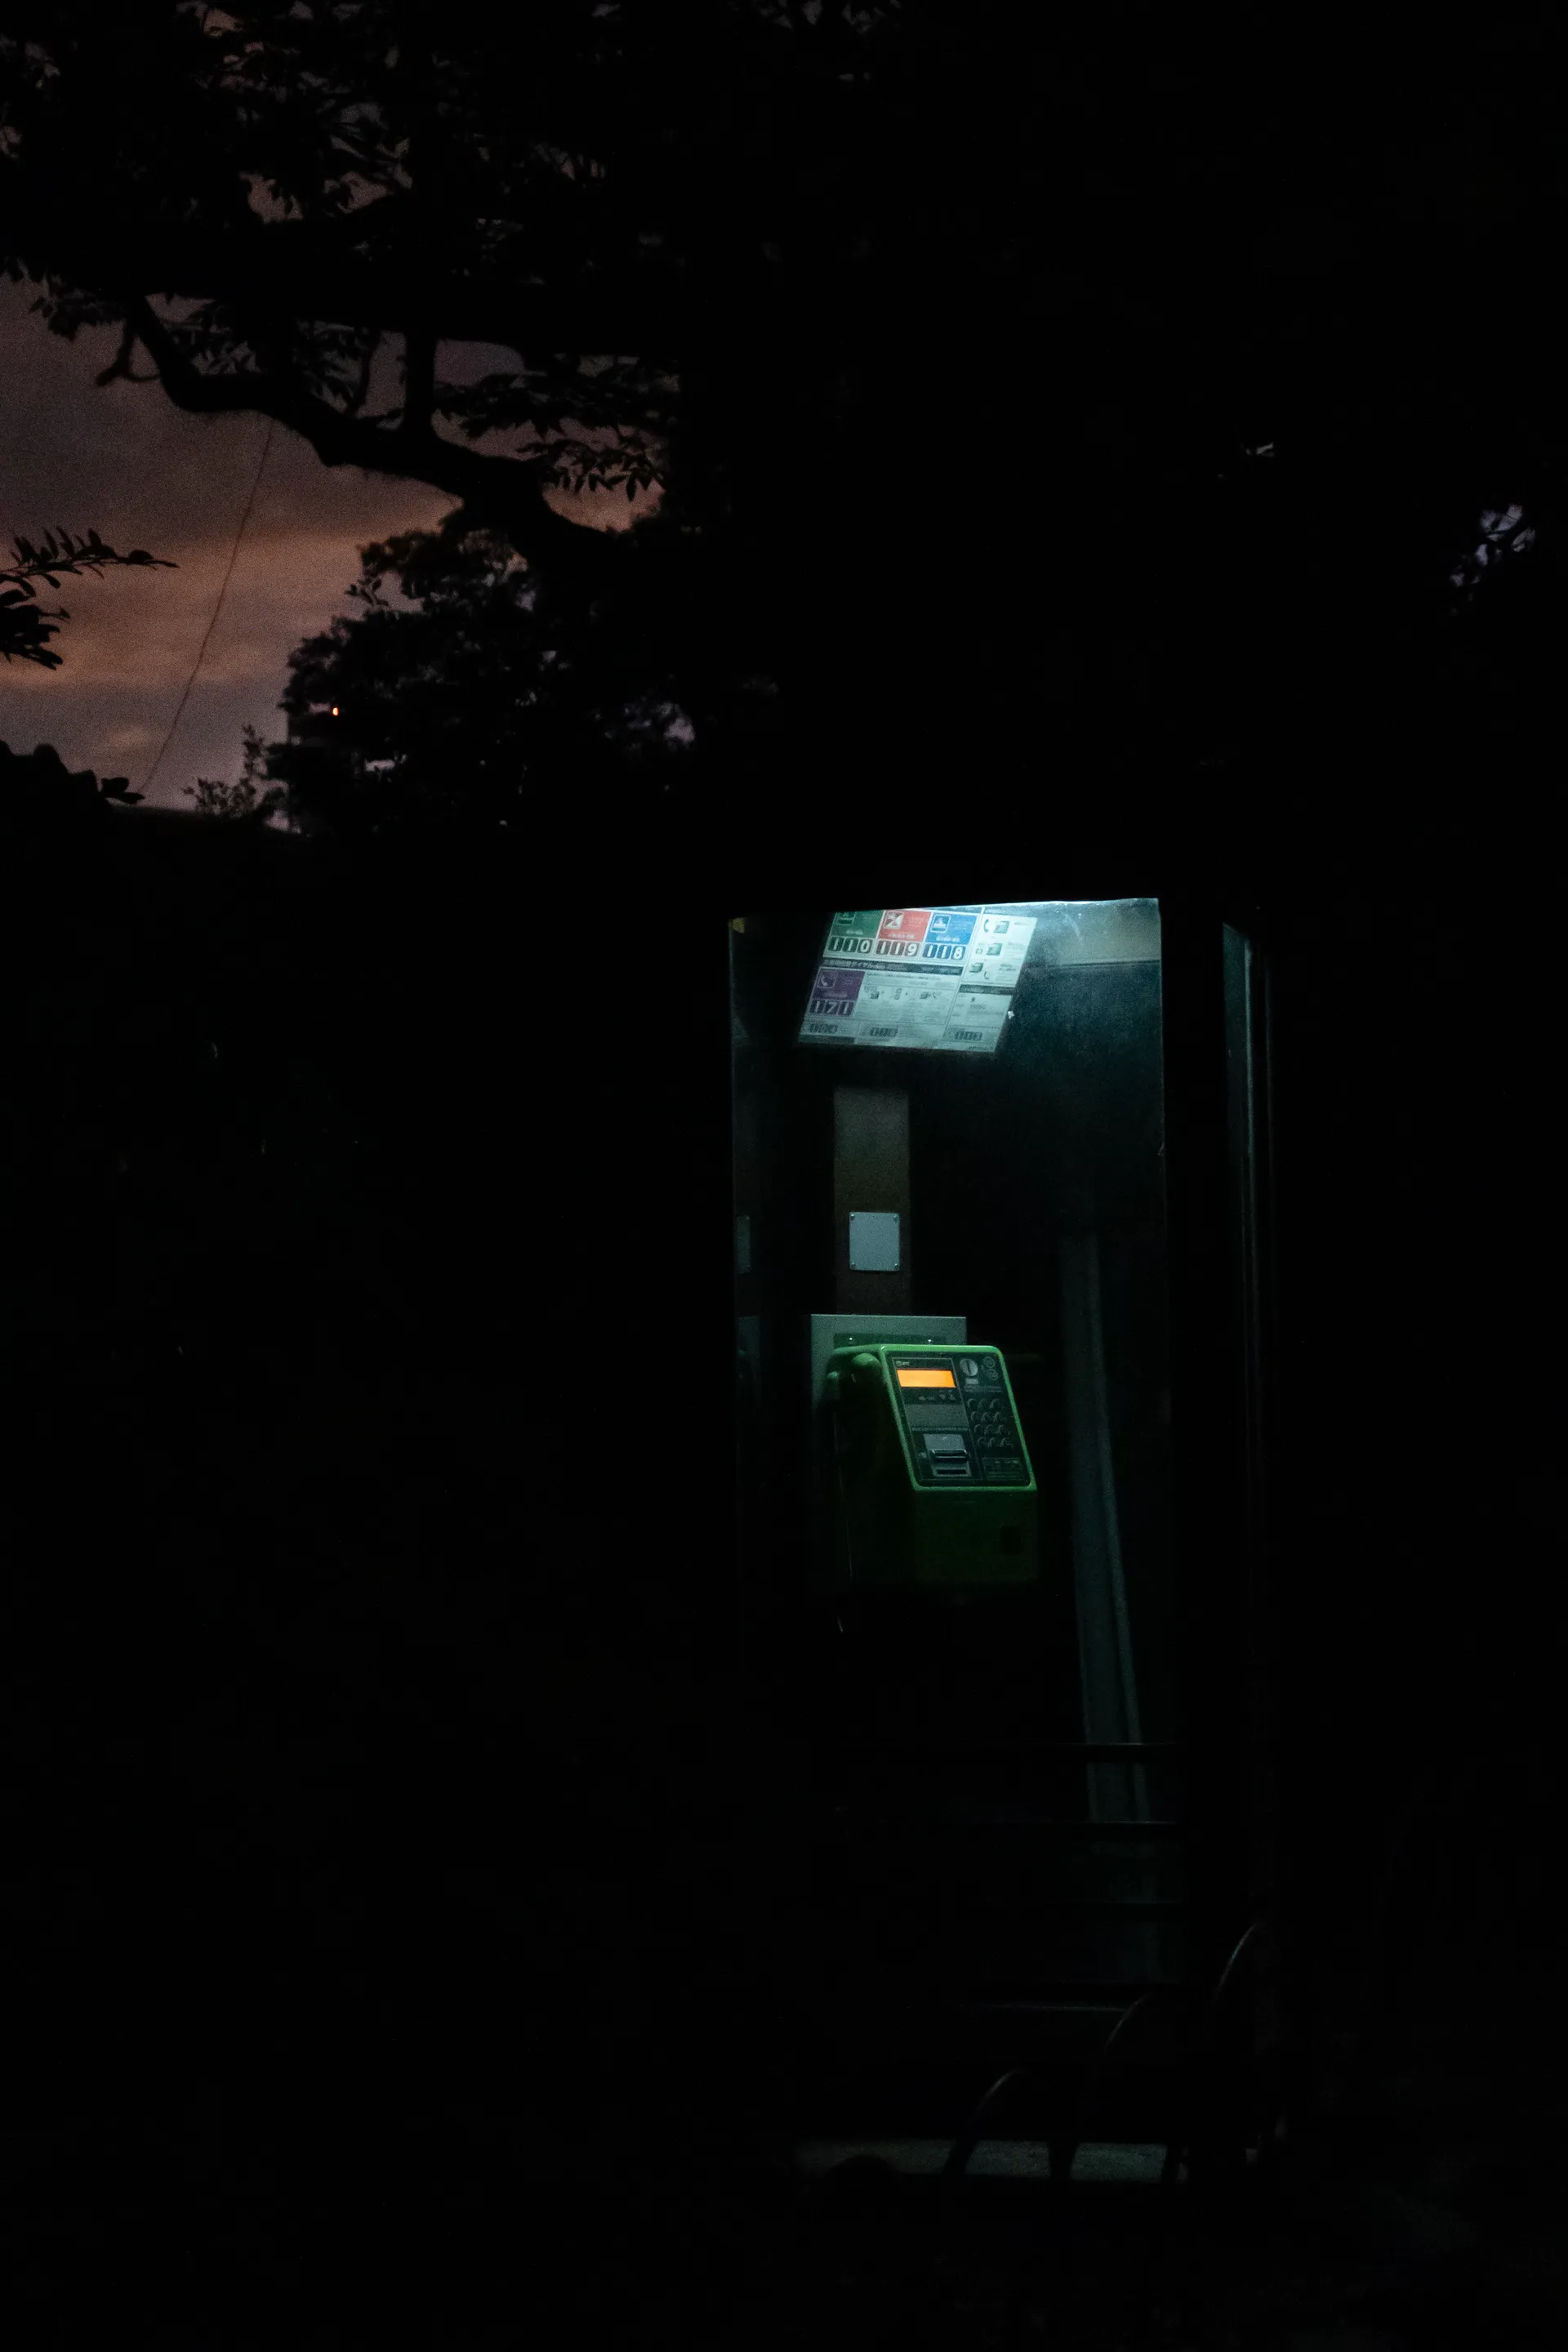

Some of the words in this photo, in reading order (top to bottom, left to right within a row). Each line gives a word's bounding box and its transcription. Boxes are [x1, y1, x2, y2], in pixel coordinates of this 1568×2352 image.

[832, 938, 871, 953] 110
[879, 941, 918, 956] 119
[926, 944, 964, 960] 118
[813, 1000, 850, 1015] 171
